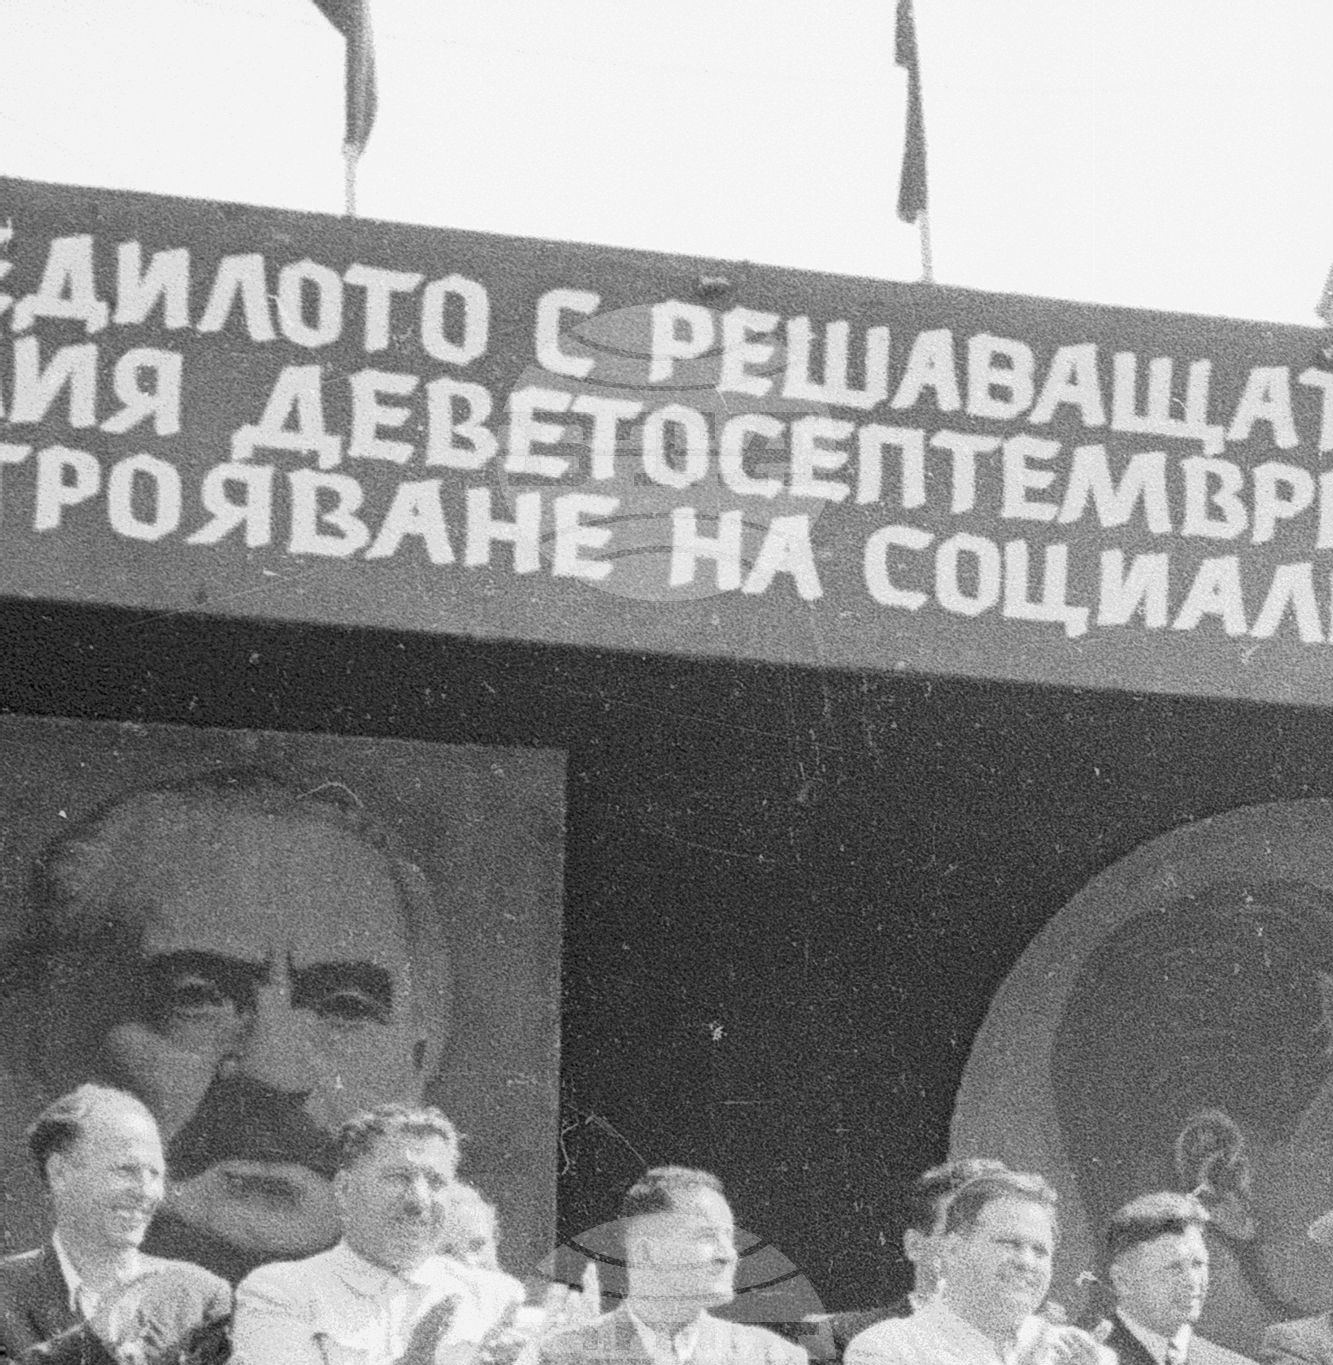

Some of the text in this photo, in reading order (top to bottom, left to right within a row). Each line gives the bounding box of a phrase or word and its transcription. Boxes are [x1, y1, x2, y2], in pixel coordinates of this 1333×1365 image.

[0, 219, 489, 365] ДИЛОТО
[535, 289, 600, 377] С
[0, 337, 183, 436] ИЯ
[668, 505, 823, 601] НА
